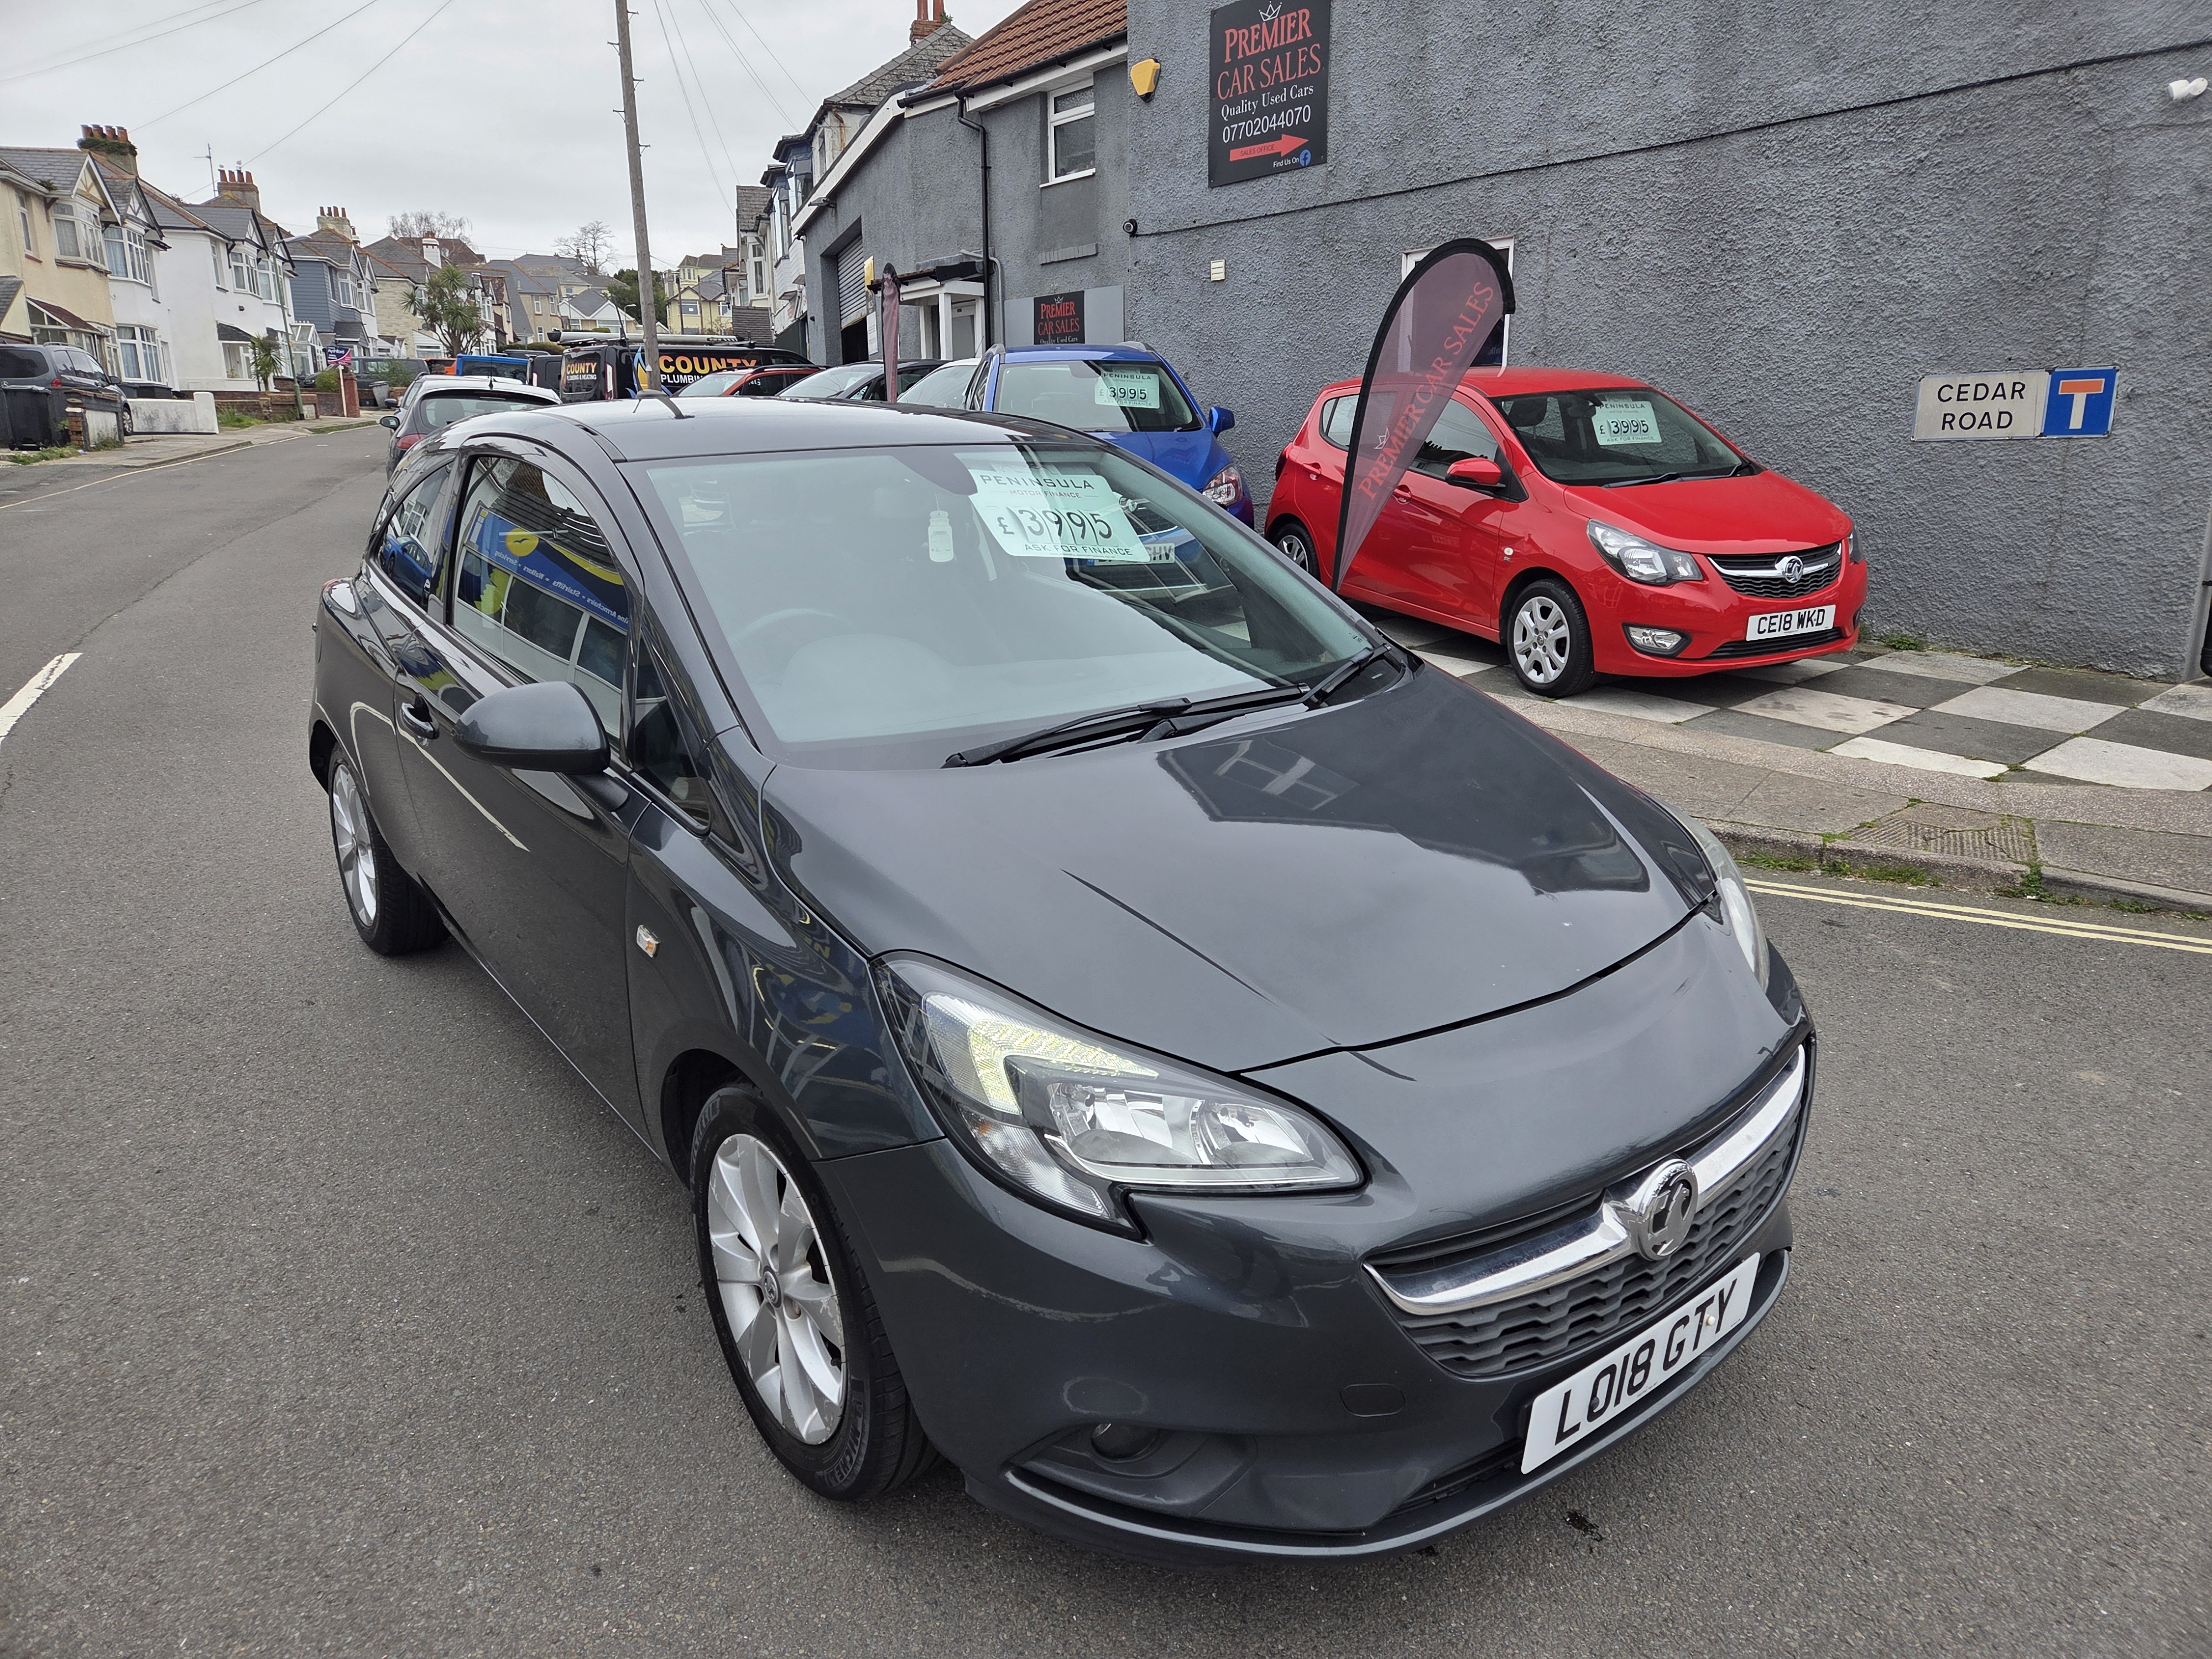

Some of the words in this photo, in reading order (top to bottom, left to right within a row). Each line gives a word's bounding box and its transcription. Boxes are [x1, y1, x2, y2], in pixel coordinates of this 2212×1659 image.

[1224, 8, 1312, 63] PREMIER
[1218, 64, 1255, 100] CAR
[1260, 43, 1321, 88] SALES
[1222, 99, 1258, 121] Quality
[1262, 88, 1286, 107] Used
[1290, 84, 1314, 99] Cars
[1223, 105, 1311, 143] 07702044070
[1257, 144, 1275, 153] OFFICE
[1273, 159, 1283, 168] Find
[1041, 301, 1076, 319] PREMIER
[1038, 321, 1054, 336] CAR
[1056, 318, 1079, 333] SALES
[567, 362, 597, 374] COUNTY
[659, 355, 757, 374] COUNTY
[1359, 403, 1426, 498] PREMIER
[1416, 356, 1452, 404] CAR
[1444, 282, 1494, 356] SALES
[1937, 382, 2026, 403] CEDAR
[1942, 411, 2013, 431] ROAD
[980, 474, 1094, 489] PENINSULA
[1052, 544, 1079, 553] FOR
[1083, 546, 1133, 556] FINANCE
[1757, 613, 1793, 634] CE18
[1797, 609, 1825, 629] WKD
[1554, 1338, 1656, 1446] LO18
[1662, 1278, 1738, 1371] GTY
